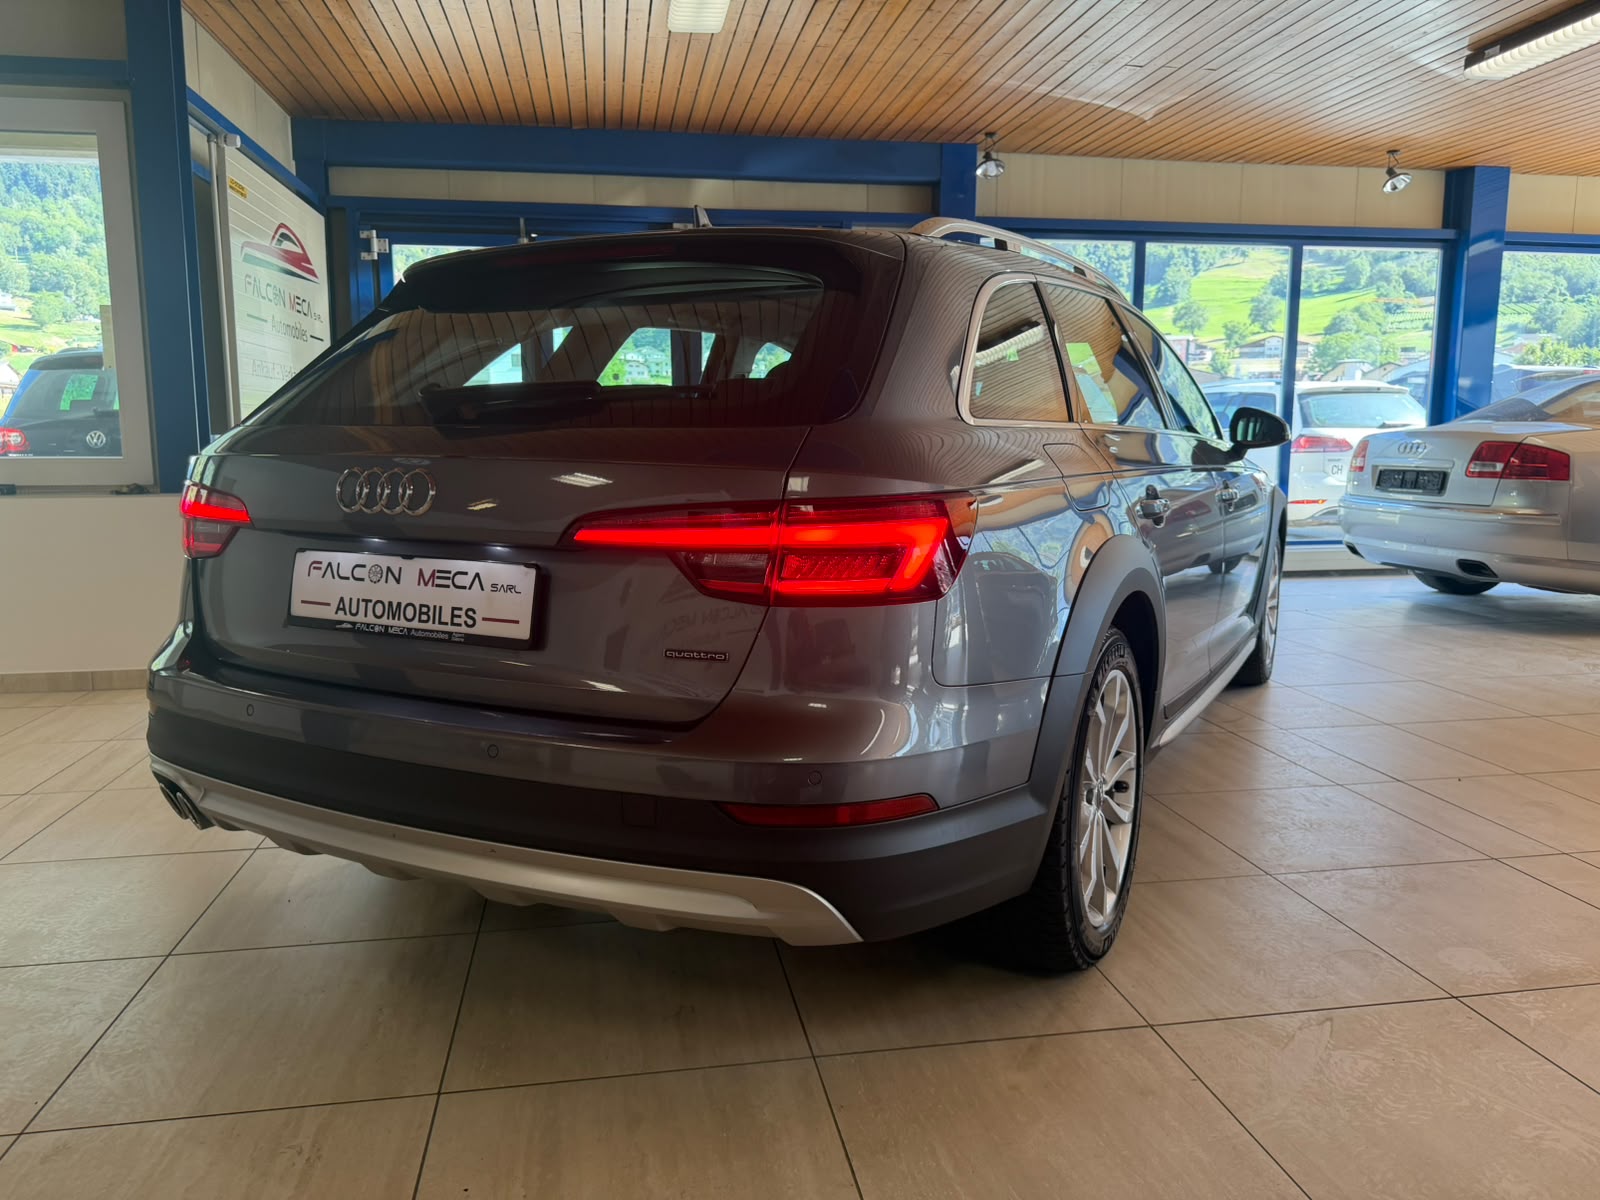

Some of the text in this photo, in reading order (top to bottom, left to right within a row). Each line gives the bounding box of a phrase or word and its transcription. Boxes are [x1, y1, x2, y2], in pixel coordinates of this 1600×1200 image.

[244, 273, 286, 309] FALCON
[288, 292, 313, 319] MECA
[271, 315, 308, 342] Automobiles
[1331, 464, 1343, 475] CH
[307, 560, 522, 594] FALCON MECA SARL
[335, 596, 477, 629] AUTOMOBILES
[355, 623, 385, 633] FALCON
[388, 626, 408, 635] MECA
[410, 629, 449, 640] Automobiles
[665, 651, 725, 660] quattro
